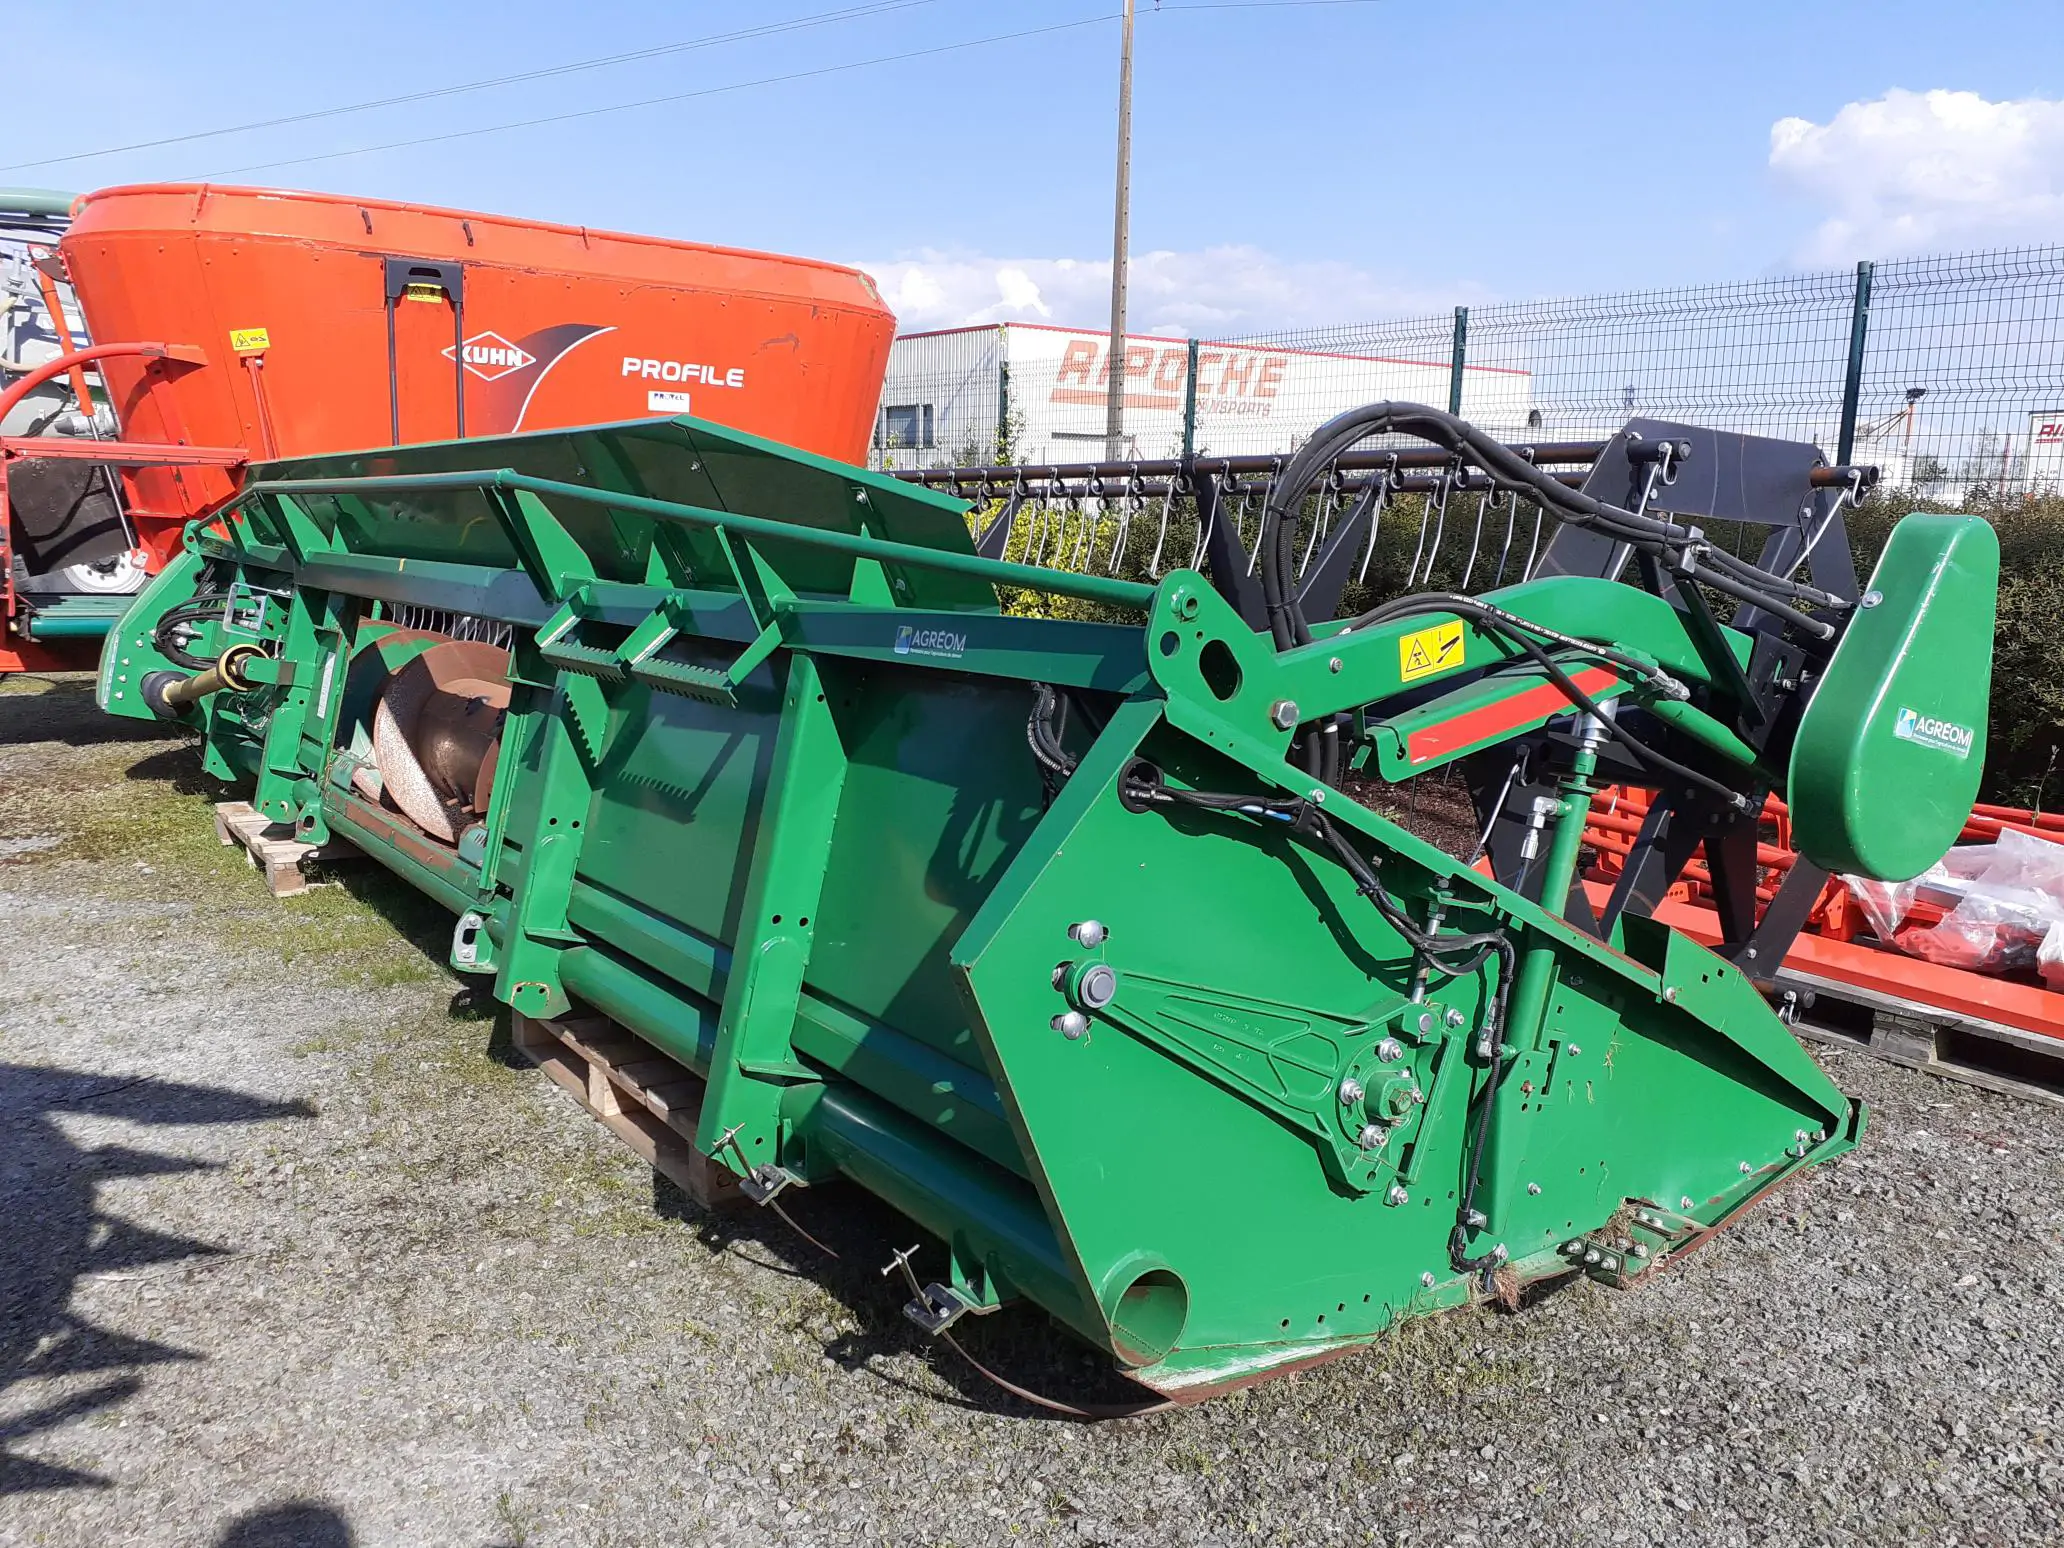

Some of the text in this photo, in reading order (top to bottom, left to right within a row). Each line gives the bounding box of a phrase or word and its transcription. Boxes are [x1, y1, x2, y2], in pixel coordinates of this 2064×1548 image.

[462, 345, 522, 367] KUHN
[621, 357, 745, 388] PROFILE
[911, 629, 967, 651] AGRÉOM
[1915, 716, 1971, 747] AGRÉOM
